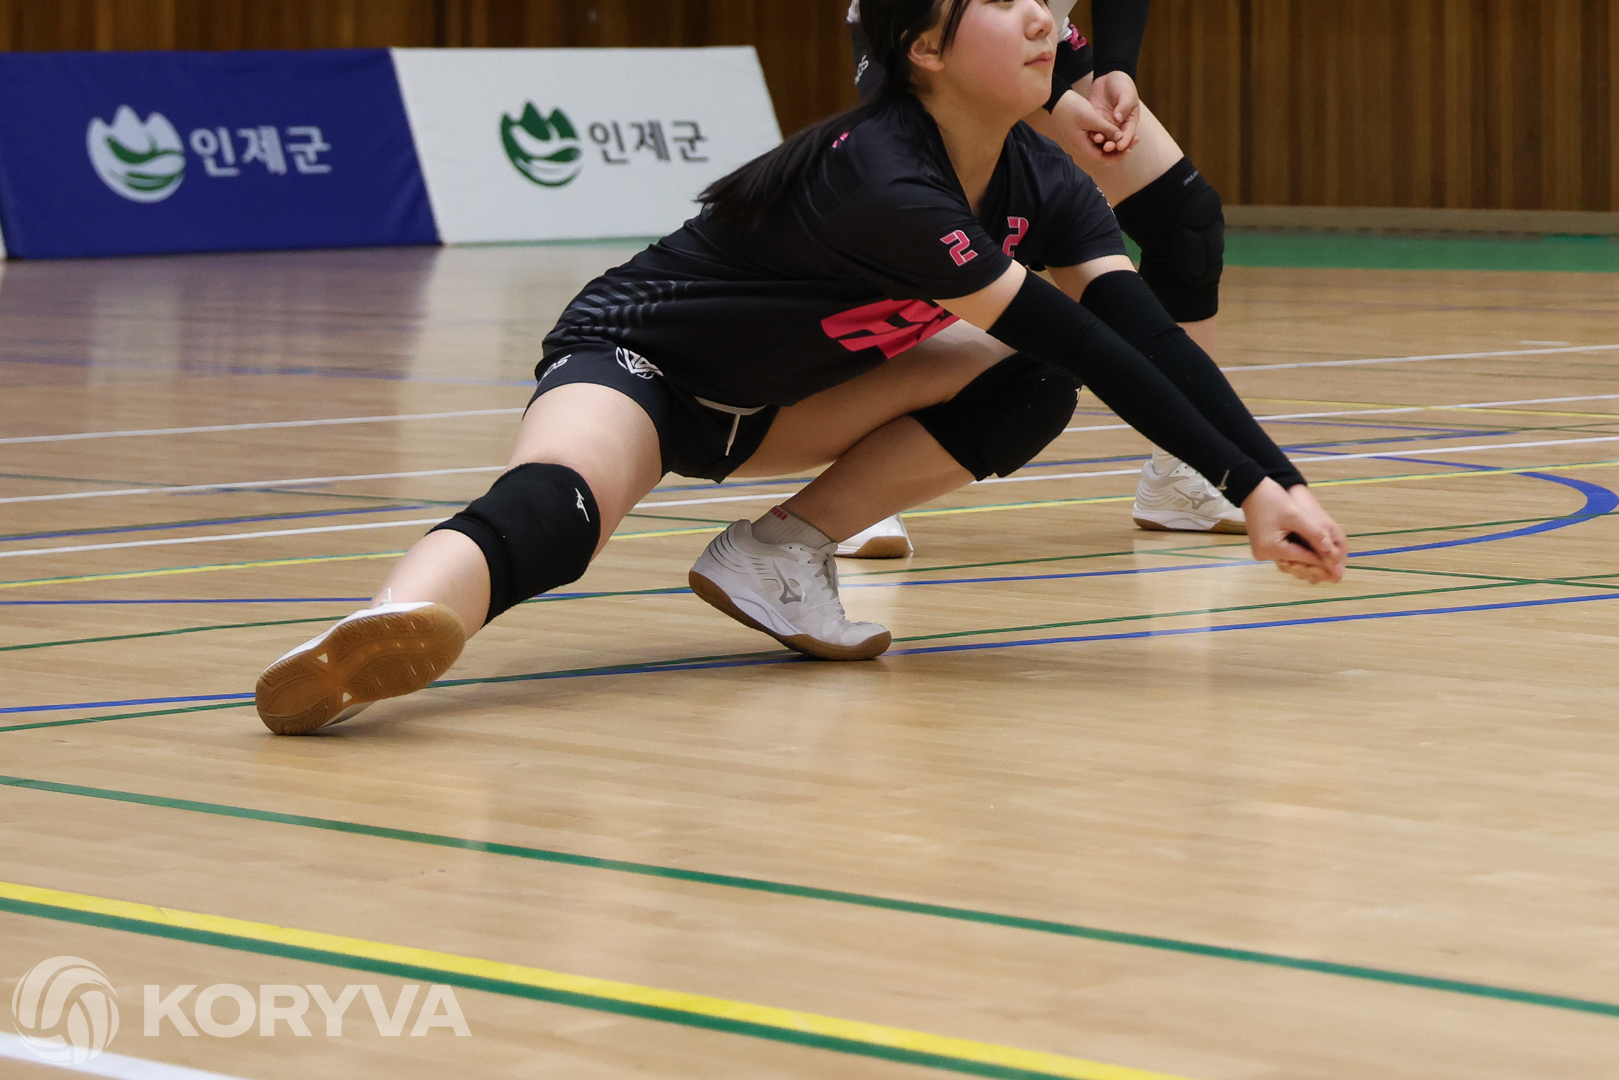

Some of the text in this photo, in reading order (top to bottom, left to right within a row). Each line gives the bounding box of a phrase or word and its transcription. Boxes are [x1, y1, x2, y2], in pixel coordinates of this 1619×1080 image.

[189, 125, 332, 178] 인제군
[589, 119, 710, 166] 인제군
[940, 229, 979, 267] 2
[1002, 216, 1030, 258] 2
